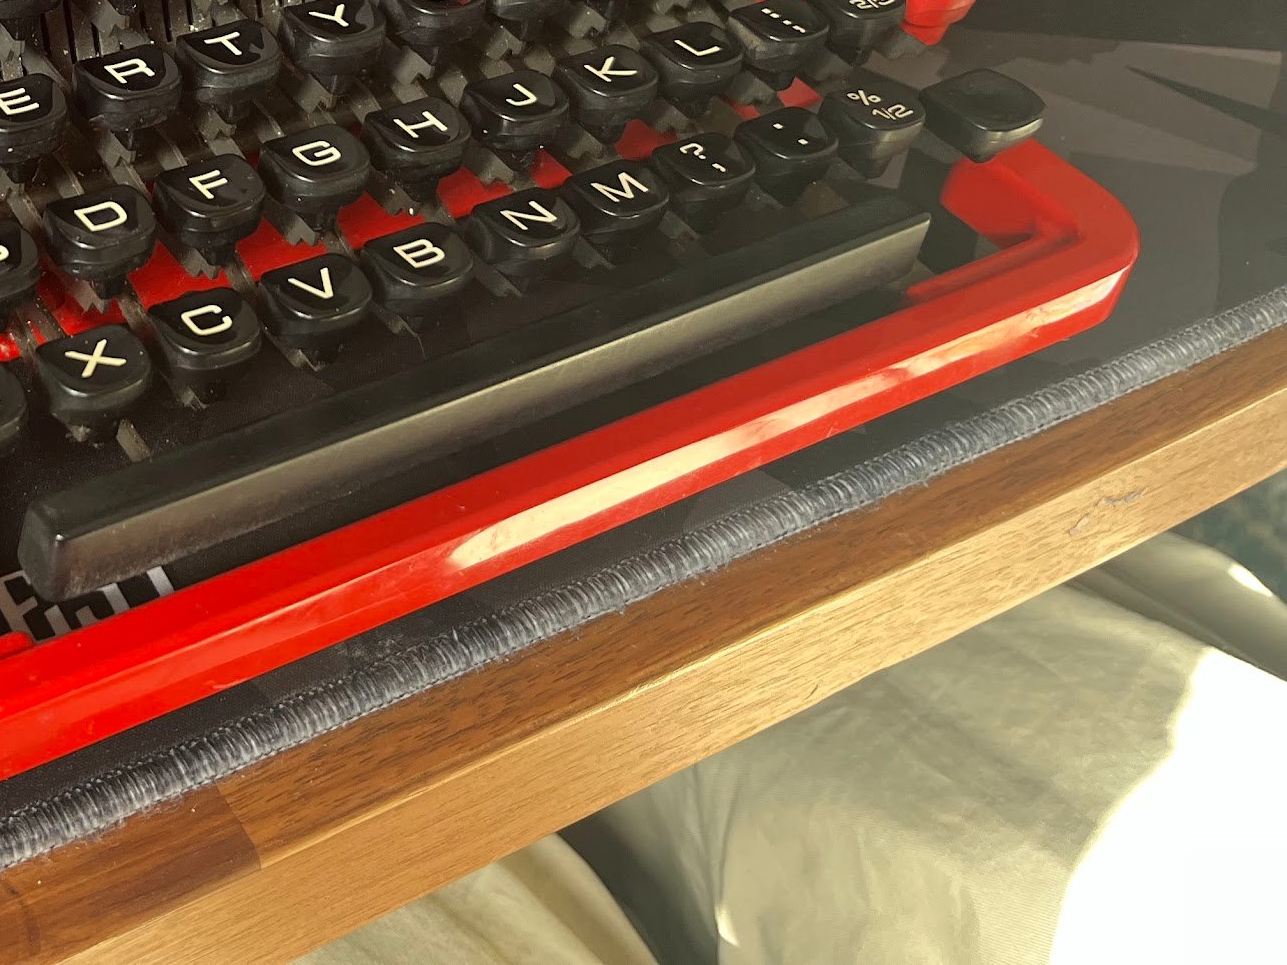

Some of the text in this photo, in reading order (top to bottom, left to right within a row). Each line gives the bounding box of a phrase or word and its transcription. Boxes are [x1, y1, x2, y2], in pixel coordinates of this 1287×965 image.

[308, 3, 349, 28] Y
[203, 31, 243, 56] T
[674, 39, 722, 56] L
[104, 58, 155, 84] R
[584, 56, 638, 82] K
[506, 83, 537, 107] J
[847, 90, 881, 106] %
[393, 111, 448, 138] H
[292, 140, 342, 166] G
[679, 142, 707, 160] ?
[188, 169, 228, 199] F
[590, 172, 649, 203] M
[74, 201, 128, 232] D
[500, 200, 557, 231] N
[393, 239, 445, 269] B
[287, 267, 334, 299] V
[181, 304, 233, 335] C
[64, 338, 127, 378] X
